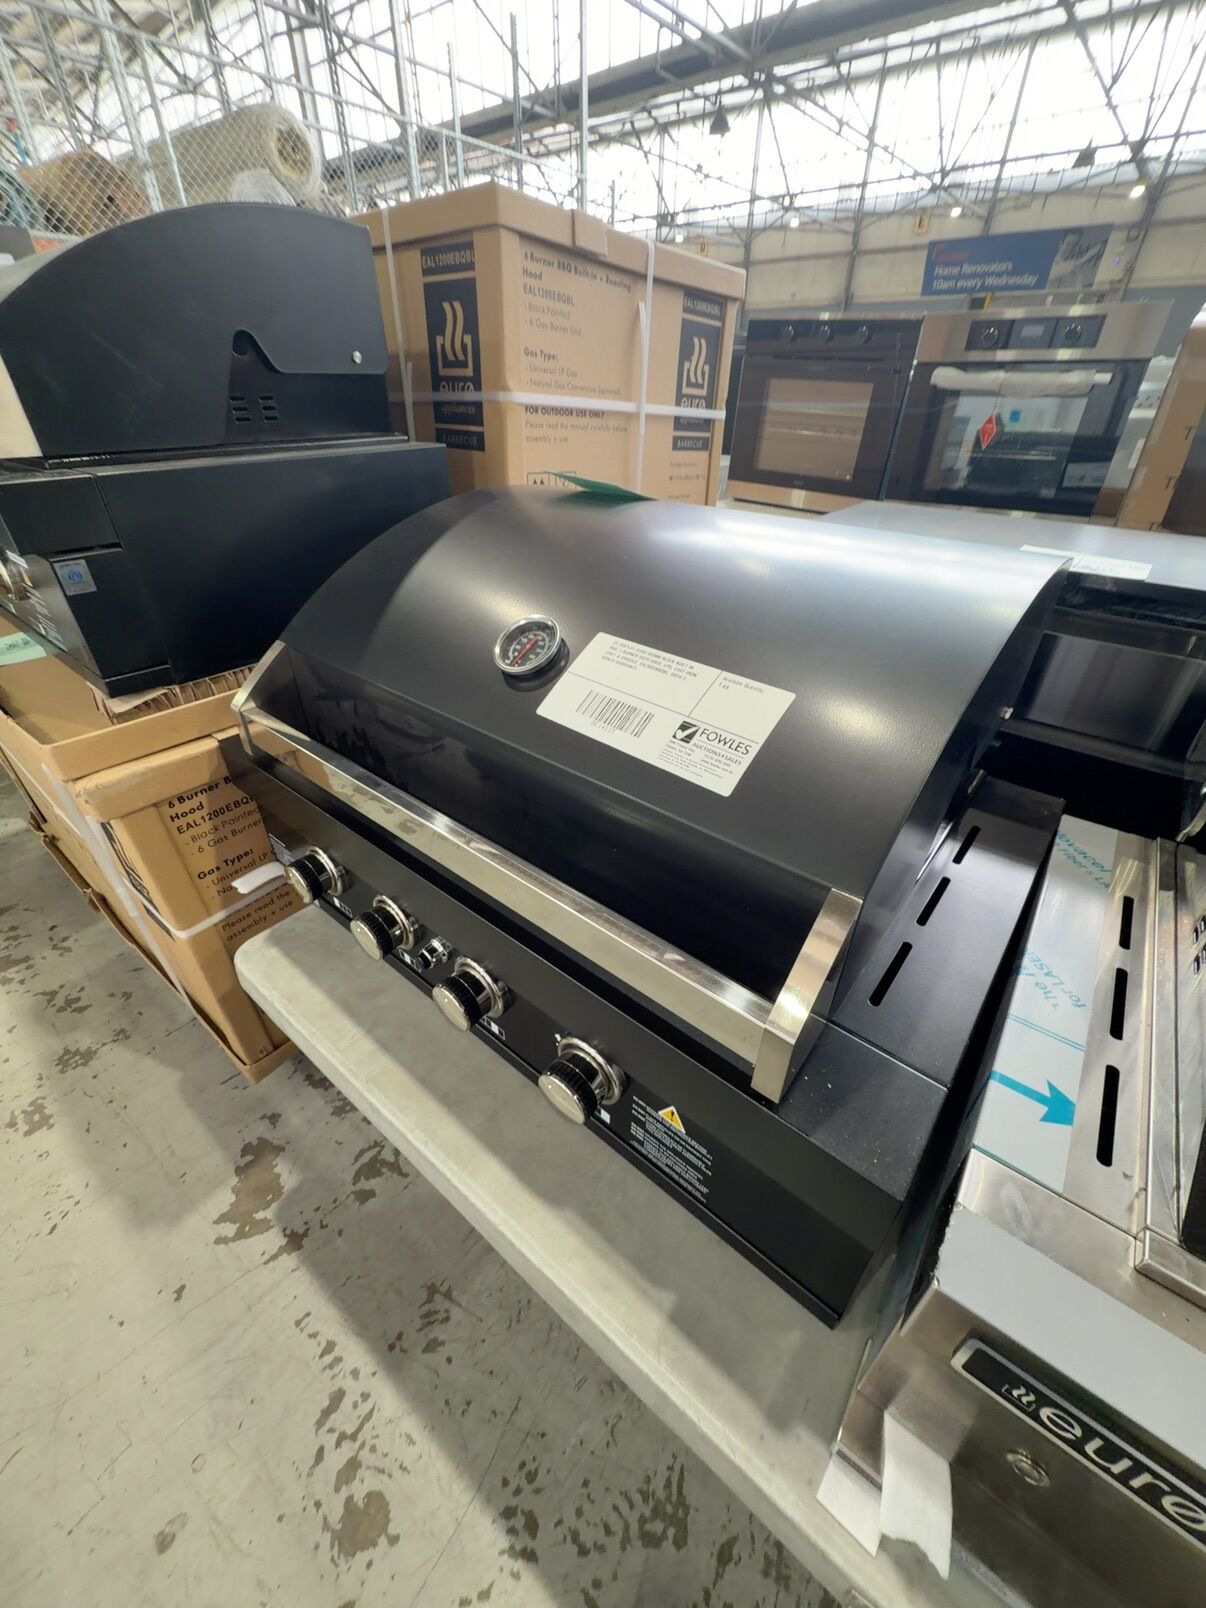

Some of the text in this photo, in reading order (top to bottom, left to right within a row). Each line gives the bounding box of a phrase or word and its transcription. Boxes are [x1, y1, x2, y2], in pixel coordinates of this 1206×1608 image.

[522, 266, 543, 281] Hood
[524, 250, 529, 260] 6
[529, 251, 555, 268] Burner
[556, 260, 572, 274] BBQ
[574, 265, 598, 281] Built-in
[934, 260, 1014, 277] Home Renovators
[933, 271, 1039, 290] 10am every Wednesday
[523, 282, 575, 306] EAL1200EBQBL
[528, 301, 572, 321] Black Painted
[535, 318, 548, 330] Gas
[549, 321, 569, 334] Burner
[523, 346, 558, 362] Gas Type:
[529, 362, 557, 375] Universal
[566, 368, 578, 378] Gas
[529, 378, 553, 389] Natural
[554, 380, 566, 391] Gas
[525, 404, 606, 419] FOR OUTDOOR USE ONLY
[525, 419, 544, 429] Please
[545, 421, 559, 431] read
[560, 421, 569, 431] the
[570, 422, 589, 431] manual
[525, 433, 552, 444] assembly
[699, 727, 752, 756] FOWLES
[168, 800, 175, 809] 6
[176, 782, 220, 805] Burner
[169, 801, 204, 823] Hood
[190, 824, 221, 843] Black
[198, 818, 262, 853] 6 Gas Burner
[197, 848, 254, 880] Gas Type:
[211, 850, 269, 886] Universal LP
[221, 890, 291, 932] Please read the
[226, 915, 268, 941] assembly
[280, 900, 294, 912] use
